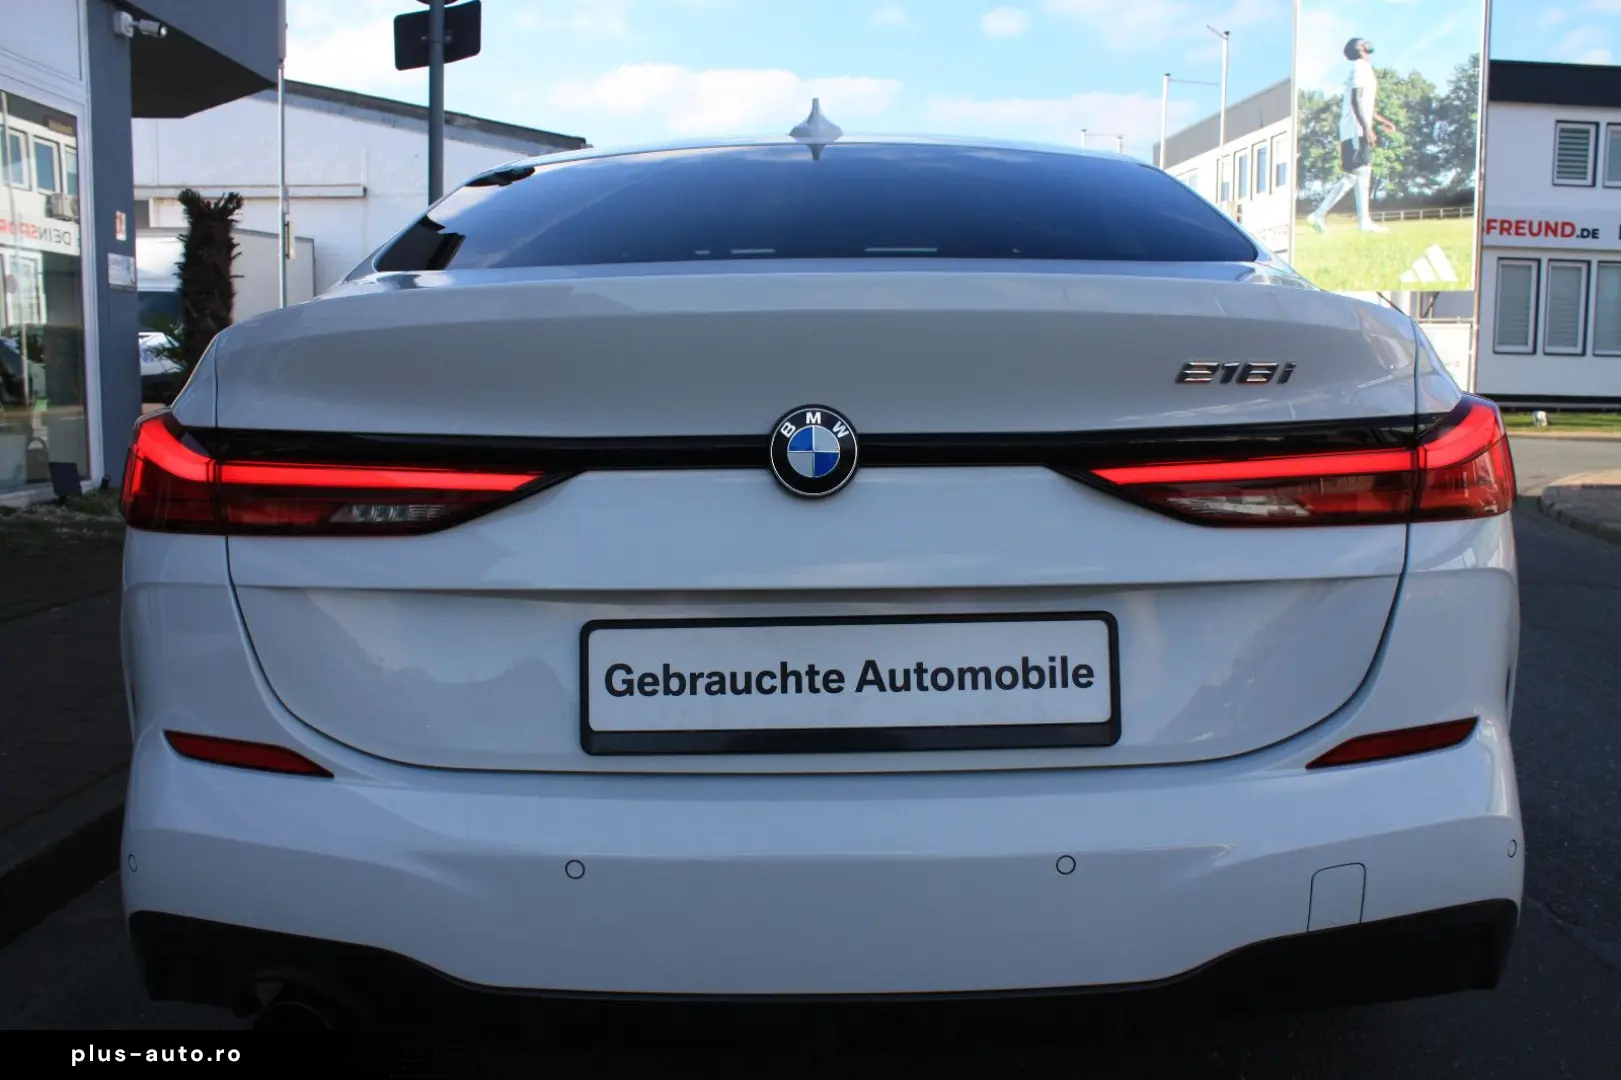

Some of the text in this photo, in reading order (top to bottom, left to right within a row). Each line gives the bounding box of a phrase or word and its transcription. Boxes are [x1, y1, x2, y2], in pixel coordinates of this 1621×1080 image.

[1482, 218, 1600, 240] FREUND.DE
[1175, 361, 1297, 384] 216i
[780, 411, 850, 438] BMW
[604, 655, 1095, 697] Gebrauchte Automobile
